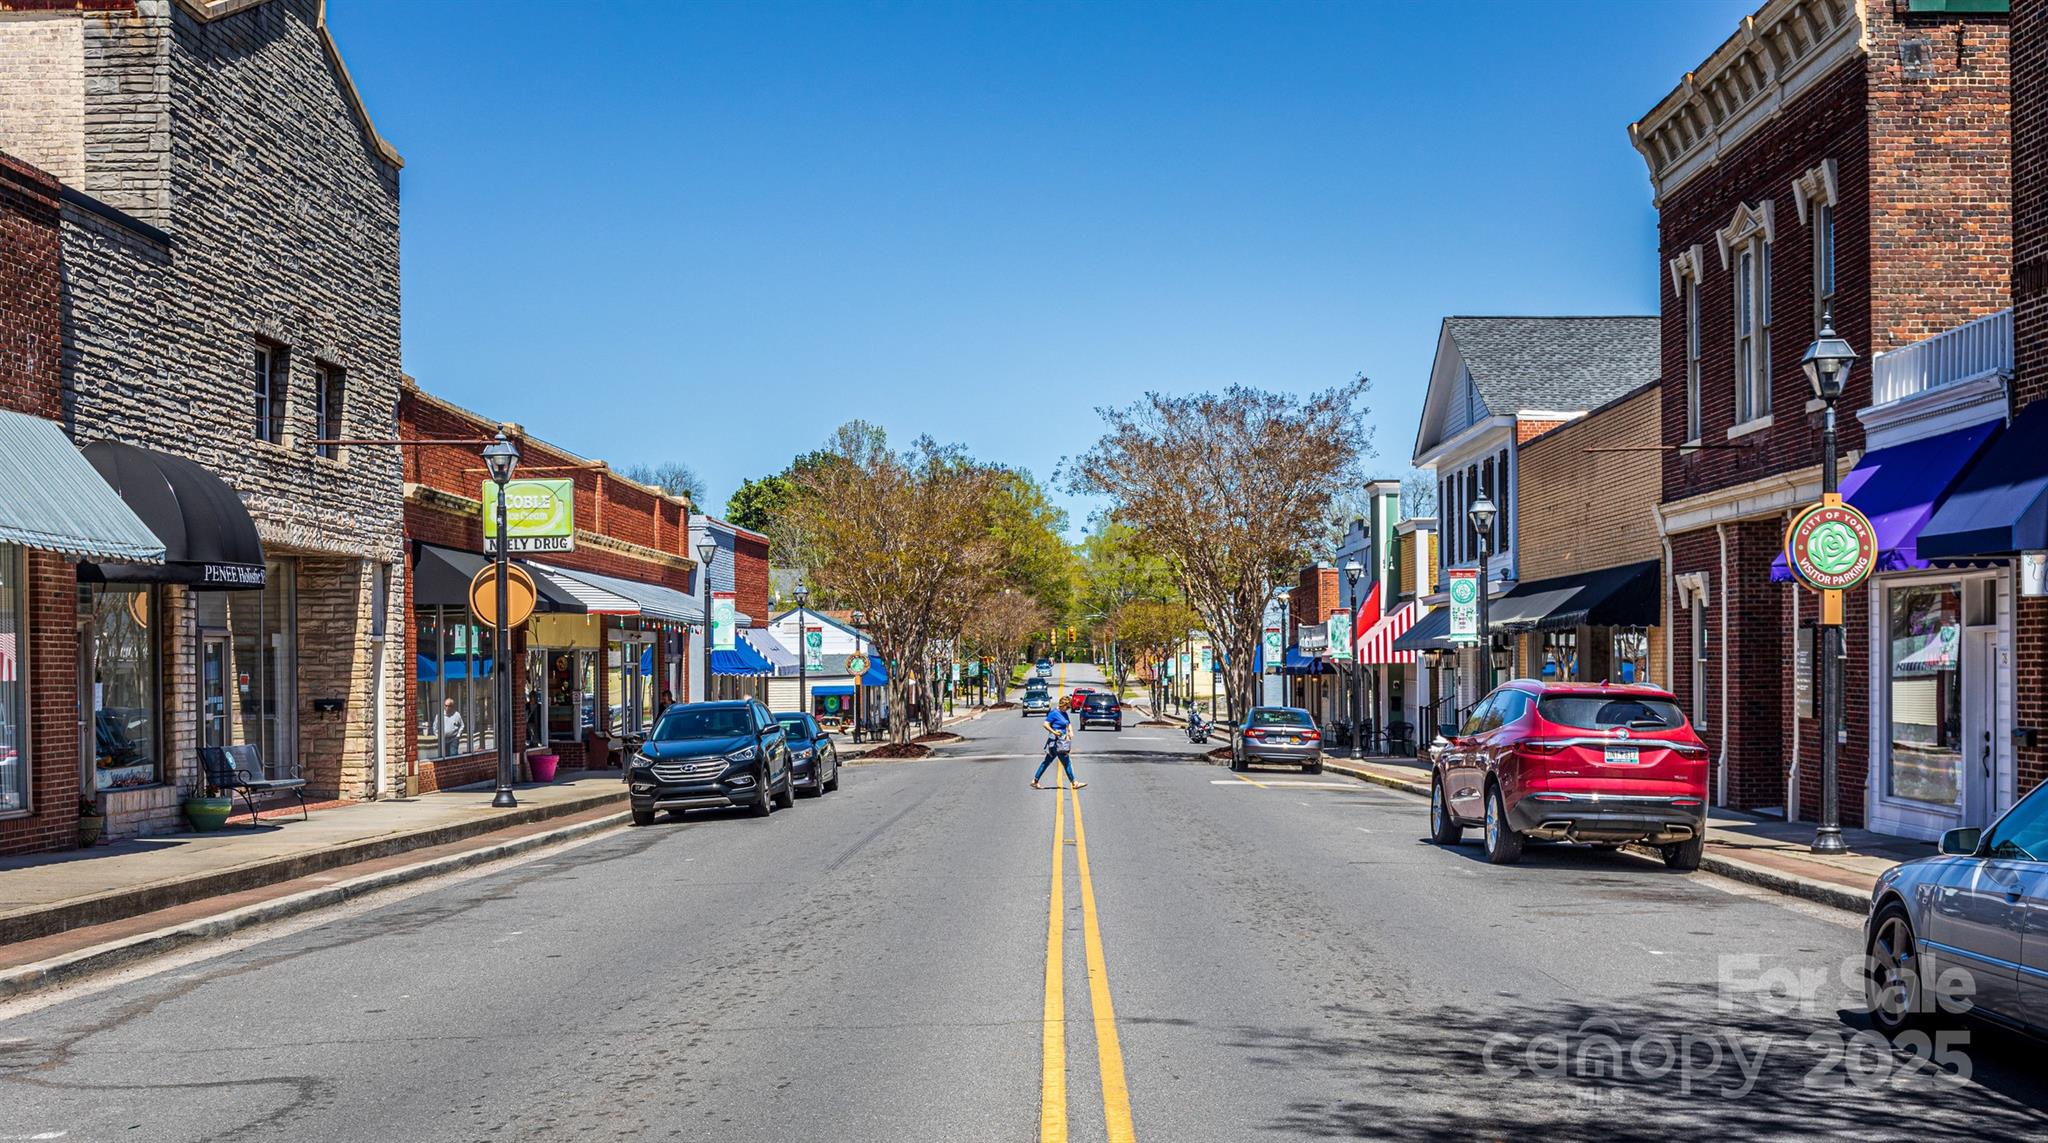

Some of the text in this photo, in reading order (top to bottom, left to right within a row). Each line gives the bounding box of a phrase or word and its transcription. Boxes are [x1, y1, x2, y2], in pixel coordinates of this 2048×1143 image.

[505, 495, 550, 509] COBLE
[1801, 511, 1867, 538] CITY OF YORK
[489, 537, 568, 550] NELY DRUG
[204, 564, 238, 582] PENEE
[1800, 557, 1868, 585] VISITOR PARKING
